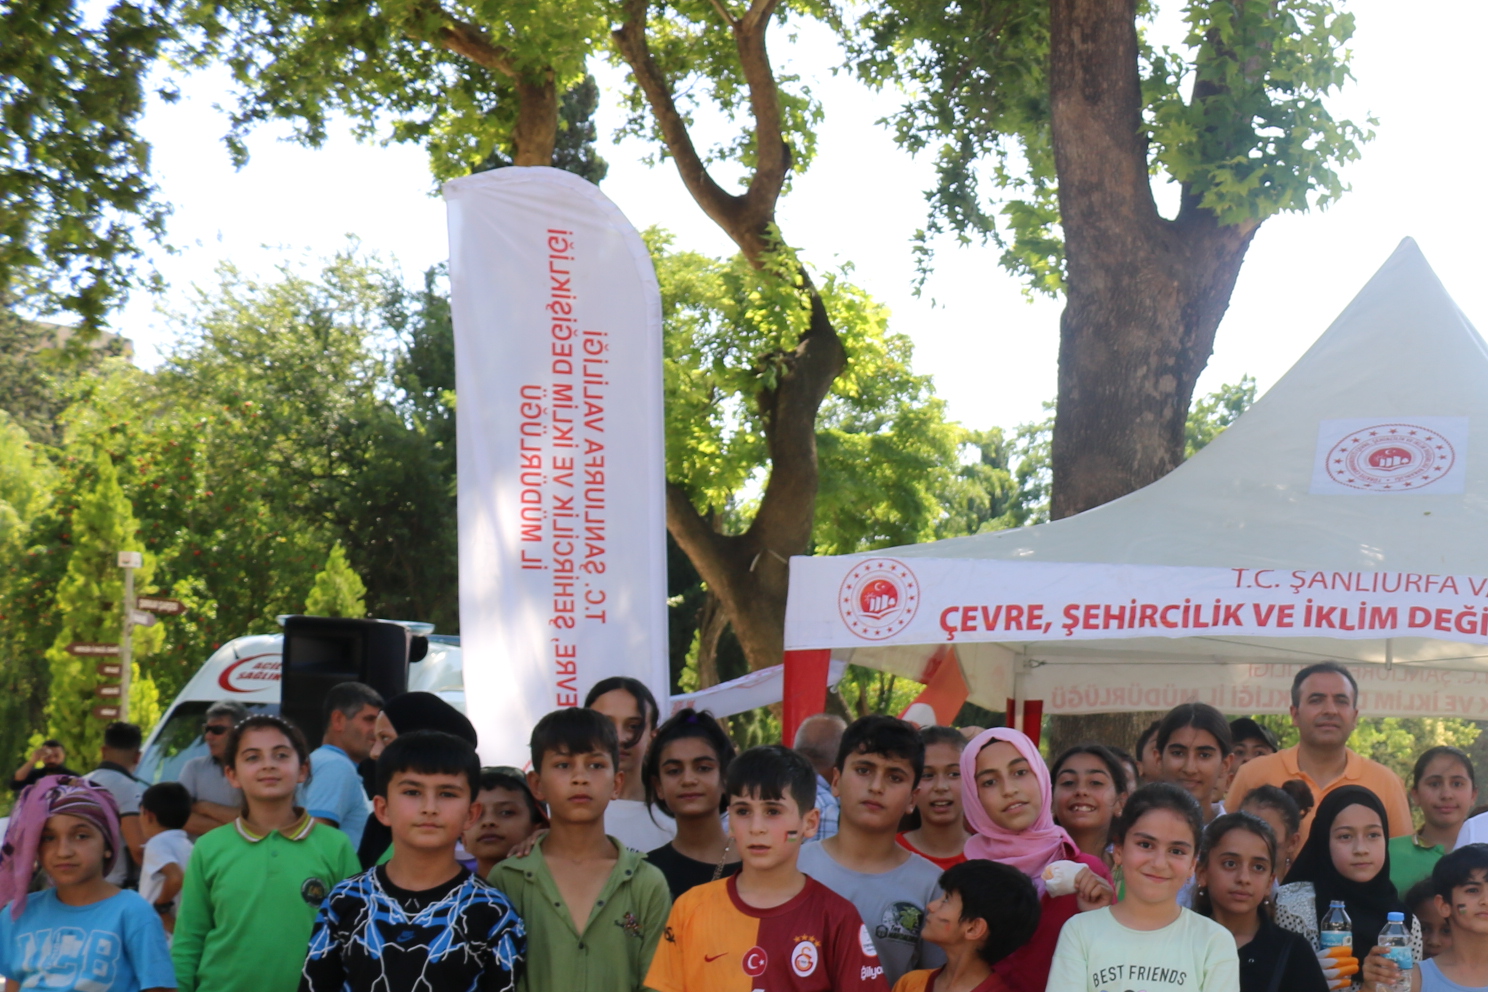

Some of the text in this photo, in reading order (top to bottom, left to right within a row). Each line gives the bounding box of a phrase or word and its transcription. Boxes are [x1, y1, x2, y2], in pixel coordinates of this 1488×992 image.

[1232, 568, 1280, 589] T.C.
[1290, 570, 1459, 595] ŞANLIURFA
[939, 604, 1052, 641] ÇEVRE,
[1062, 598, 1246, 636] ŞEHİRCİLİK
[1252, 603, 1295, 628] VE
[1303, 598, 1398, 631] İKLİM
[1093, 964, 1187, 988] BEST FRIENDS
